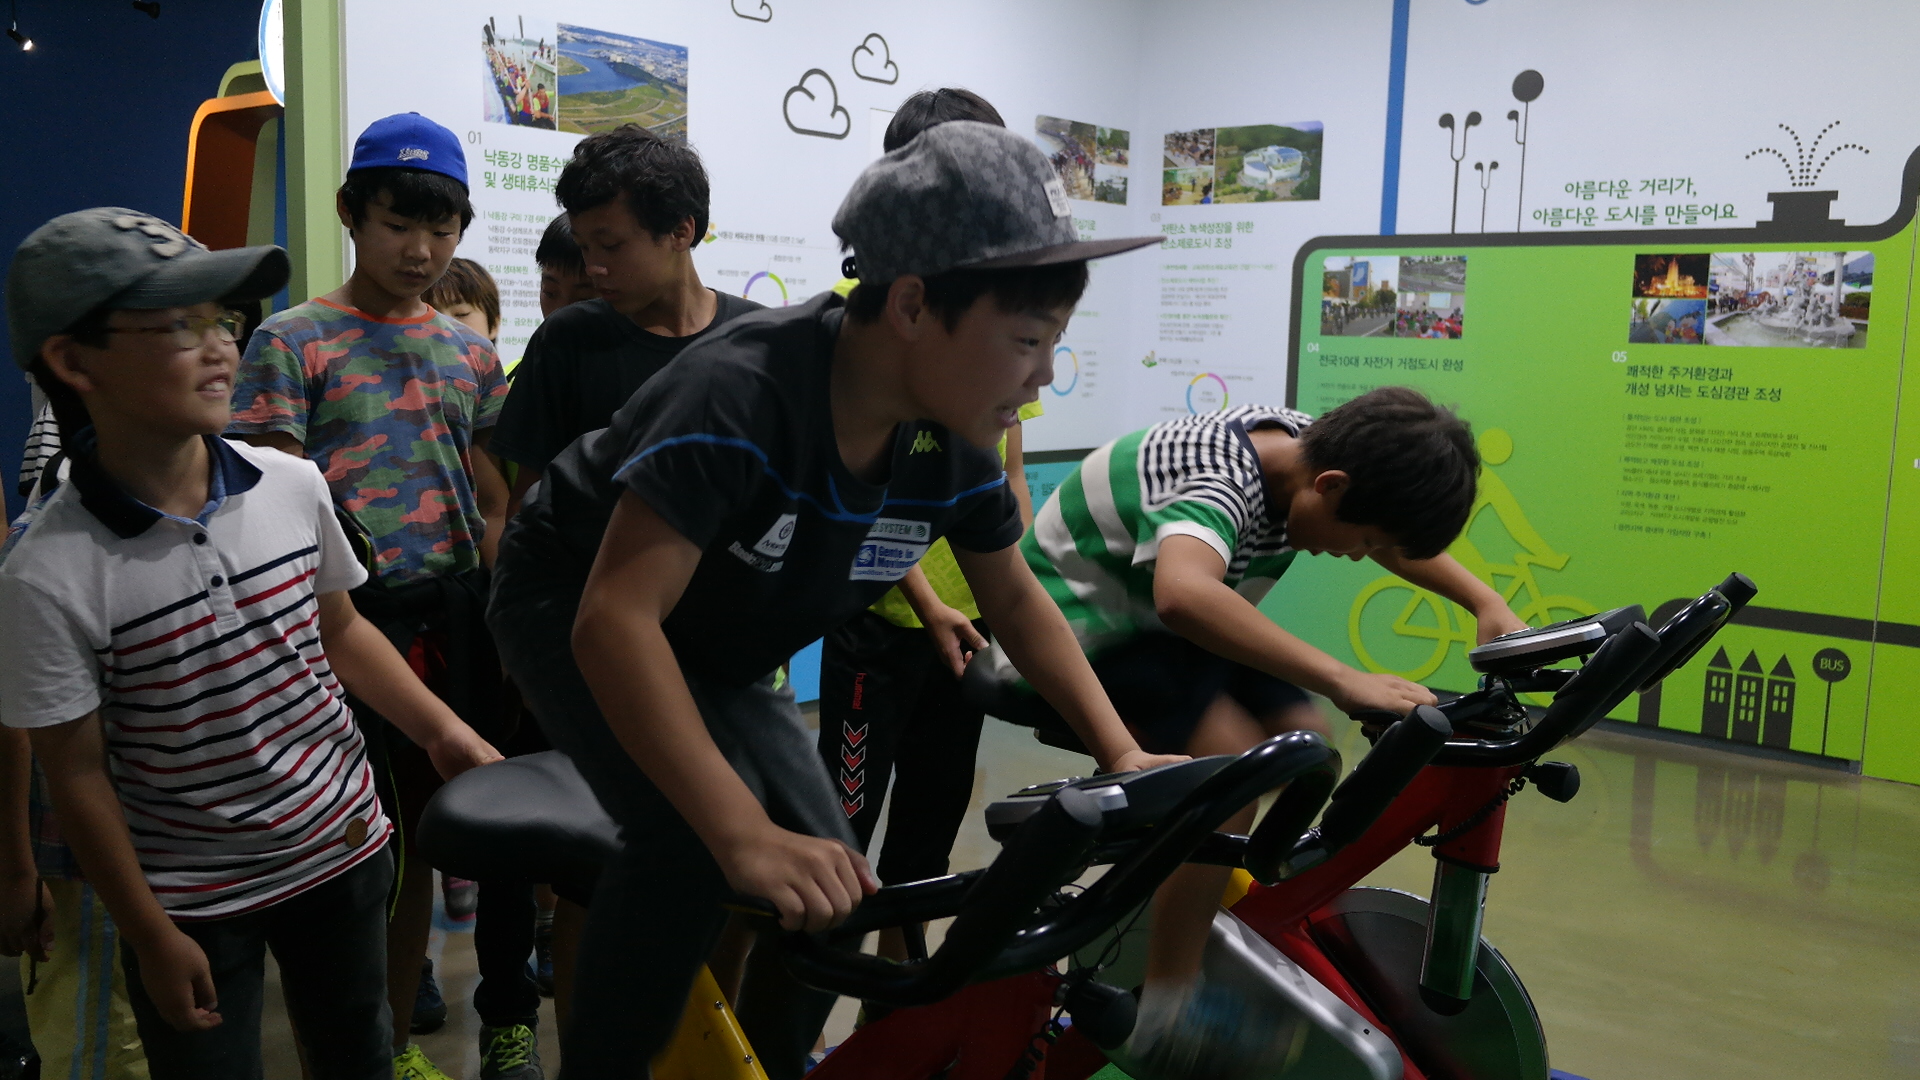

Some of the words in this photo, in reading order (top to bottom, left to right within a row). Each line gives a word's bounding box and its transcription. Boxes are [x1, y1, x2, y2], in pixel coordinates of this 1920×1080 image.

[467, 130, 482, 145] 01
[484, 149, 522, 170] 낙동강
[484, 171, 496, 188] 및
[1564, 180, 1632, 200] 아름다운
[1639, 178, 1697, 197] 거리가,
[1533, 207, 1598, 227] 아름다운
[1604, 206, 1658, 225] 도시를
[1664, 204, 1738, 225] 만들어요
[1161, 223, 1186, 235] 저탄소
[1190, 222, 1233, 234] 녹색성장을
[1236, 221, 1254, 233] 위한
[1214, 238, 1232, 249] 조성
[1307, 343, 1319, 352] 04
[1319, 355, 1359, 368] 전국10대
[1363, 357, 1393, 370] 자전거
[1398, 358, 1438, 370] 거점도시
[1442, 359, 1463, 371] 완성
[1612, 351, 1627, 362] 05
[1627, 365, 1664, 379] 쾌적한
[1668, 367, 1733, 381] 주거환경과
[1625, 383, 1650, 396] 개성
[1655, 384, 1692, 398] 넘치는
[1696, 386, 1750, 401] 도심경관
[1754, 388, 1782, 402] 조성
[880, 522, 912, 535] SYSTEM
[1820, 657, 1844, 671] BUS
[852, 672, 868, 710] hummel
